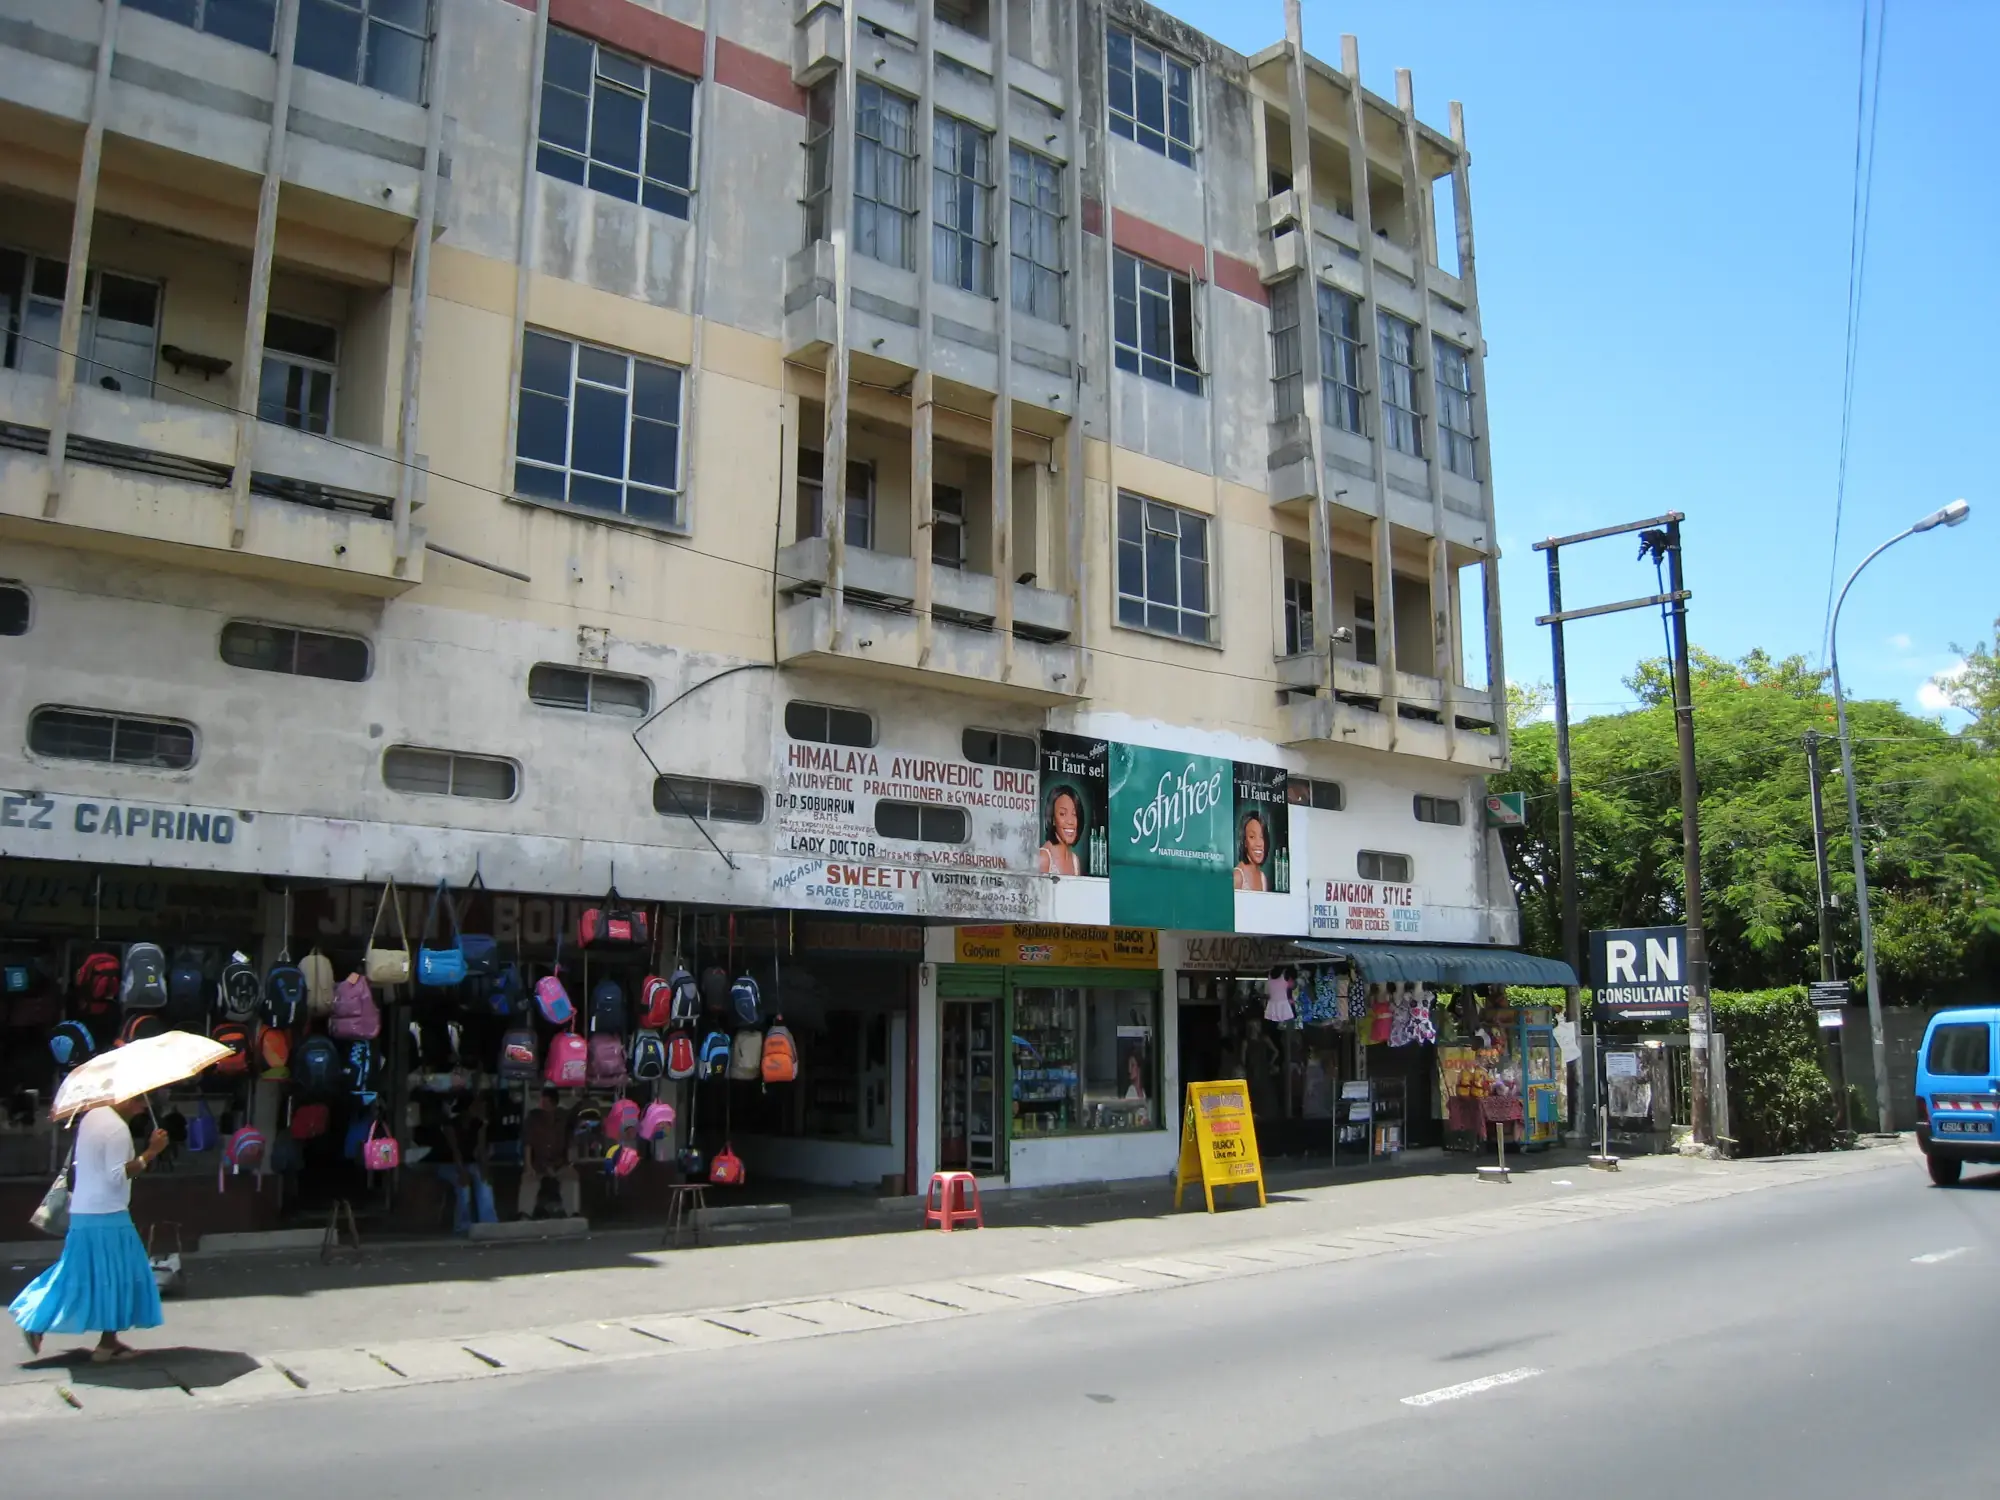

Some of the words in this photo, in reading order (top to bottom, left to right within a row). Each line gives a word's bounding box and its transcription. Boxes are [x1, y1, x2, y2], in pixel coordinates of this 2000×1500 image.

[788, 744, 878, 776] HIMALAYA
[891, 757, 983, 789] AYURVEDIC
[994, 770, 1035, 795] DRUG
[1048, 755, 1058, 772] Il
[1062, 758, 1086, 776] faut
[1089, 763, 1104, 778] se!
[788, 772, 853, 792] AYURVEDIC
[864, 780, 943, 801] PRACTITIONER
[1240, 784, 1248, 799] Il
[1251, 786, 1270, 802] faut
[1272, 790, 1285, 804] se!
[800, 795, 854, 814] SOBURRUN
[1, 796, 55, 830] EZ
[74, 803, 235, 844] CAPRINO
[791, 836, 825, 853] LADY
[830, 839, 875, 858] DOCTOR
[772, 859, 823, 891] MAGASIN
[827, 864, 920, 889] SWEETY
[932, 872, 976, 885] VISITING
[806, 885, 849, 898] SAREE
[854, 888, 893, 901] PALACE
[1325, 882, 1374, 904] BANGKOK
[1383, 886, 1412, 906] STYLE
[824, 897, 850, 907] DANS
[854, 900, 865, 909] LE
[868, 901, 905, 911] COULOIR
[1314, 905, 1332, 916] PRET
[1333, 906, 1338, 917] A
[1348, 906, 1385, 919] UNIFORMES
[1313, 917, 1339, 929] PORTER
[1345, 919, 1363, 930] POUR
[1364, 920, 1389, 931] ECOLES
[1606, 937, 1679, 983] R.N
[1597, 985, 1689, 1004] CONSULTANTS
